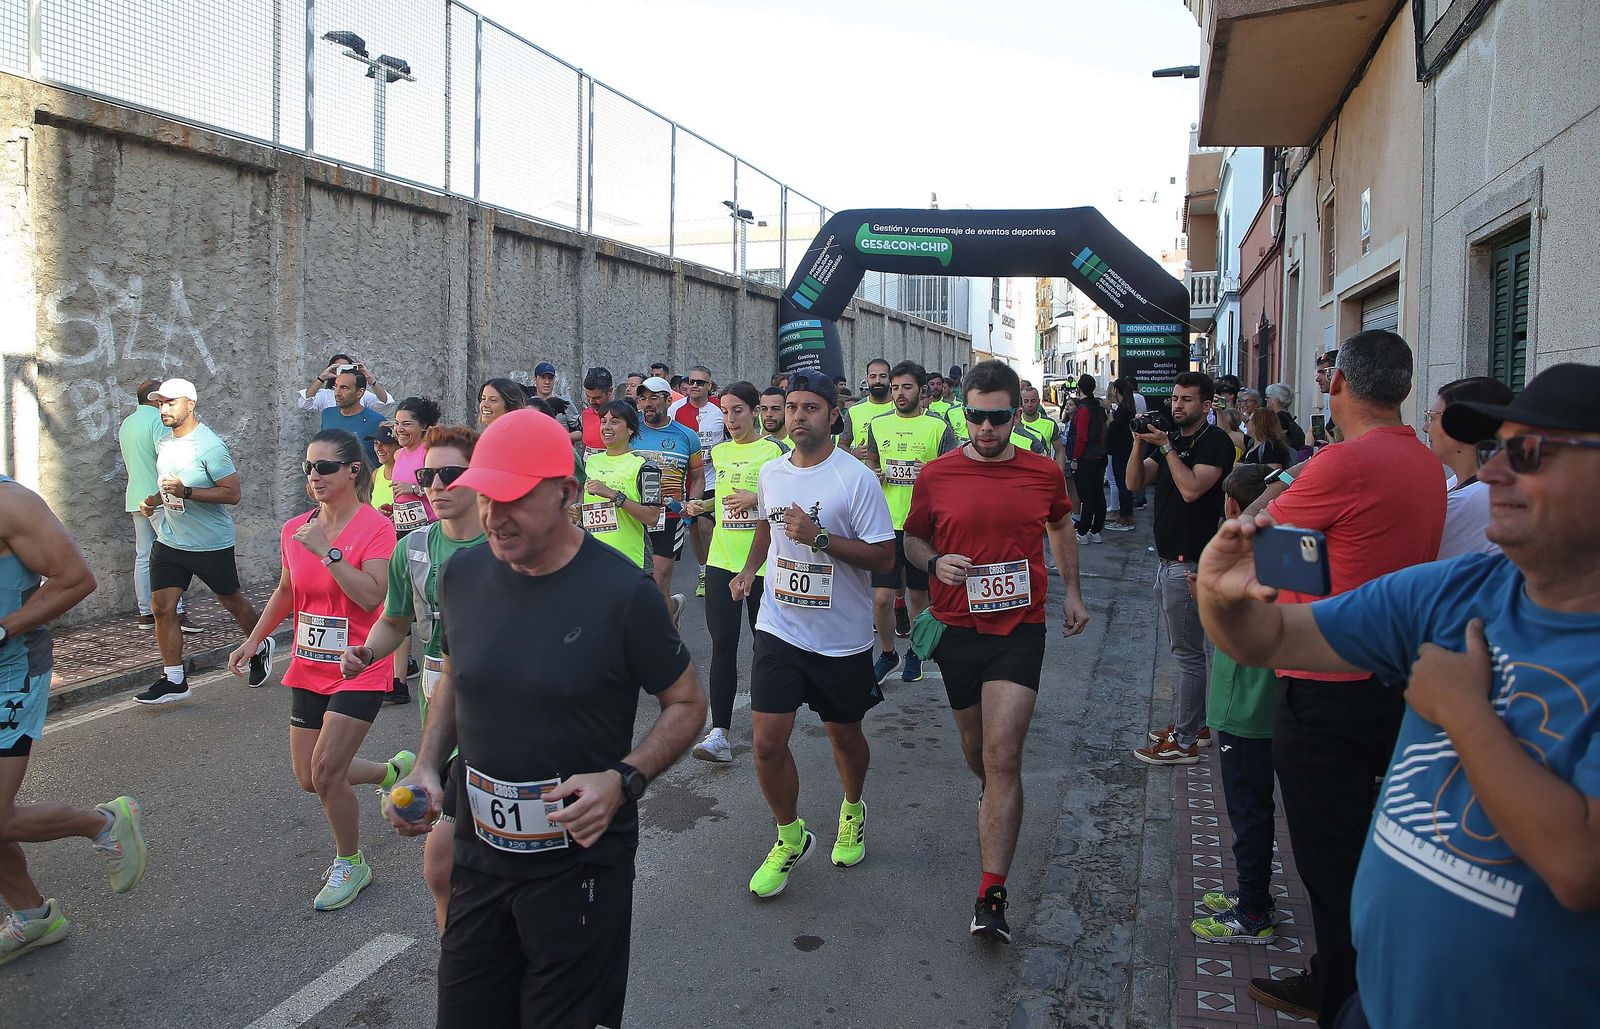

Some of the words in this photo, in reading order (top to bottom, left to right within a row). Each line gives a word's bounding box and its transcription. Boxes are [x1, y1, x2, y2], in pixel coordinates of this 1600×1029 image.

[873, 224, 902, 233] Gestión
[912, 226, 963, 236] cronometraje
[965, 227, 976, 235] de
[1012, 228, 1056, 237] deportivos
[861, 239, 949, 252] GES&CON-CHIP
[1099, 278, 1121, 298] SERIEDAD
[1108, 268, 1147, 304] PROFESIONALIDAD
[1096, 282, 1124, 308] COMPROMISO
[892, 466, 912, 478] 334
[398, 510, 417, 522] 316
[589, 510, 608, 524] 355
[794, 562, 809, 572] CROSS
[989, 565, 1006, 574] CROSS
[790, 572, 810, 593] 60
[980, 575, 1015, 598] 365
[308, 627, 326, 647] 57
[494, 783, 518, 799] CROSS
[491, 799, 522, 832] 61
[1432, 848, 1457, 867] THE
